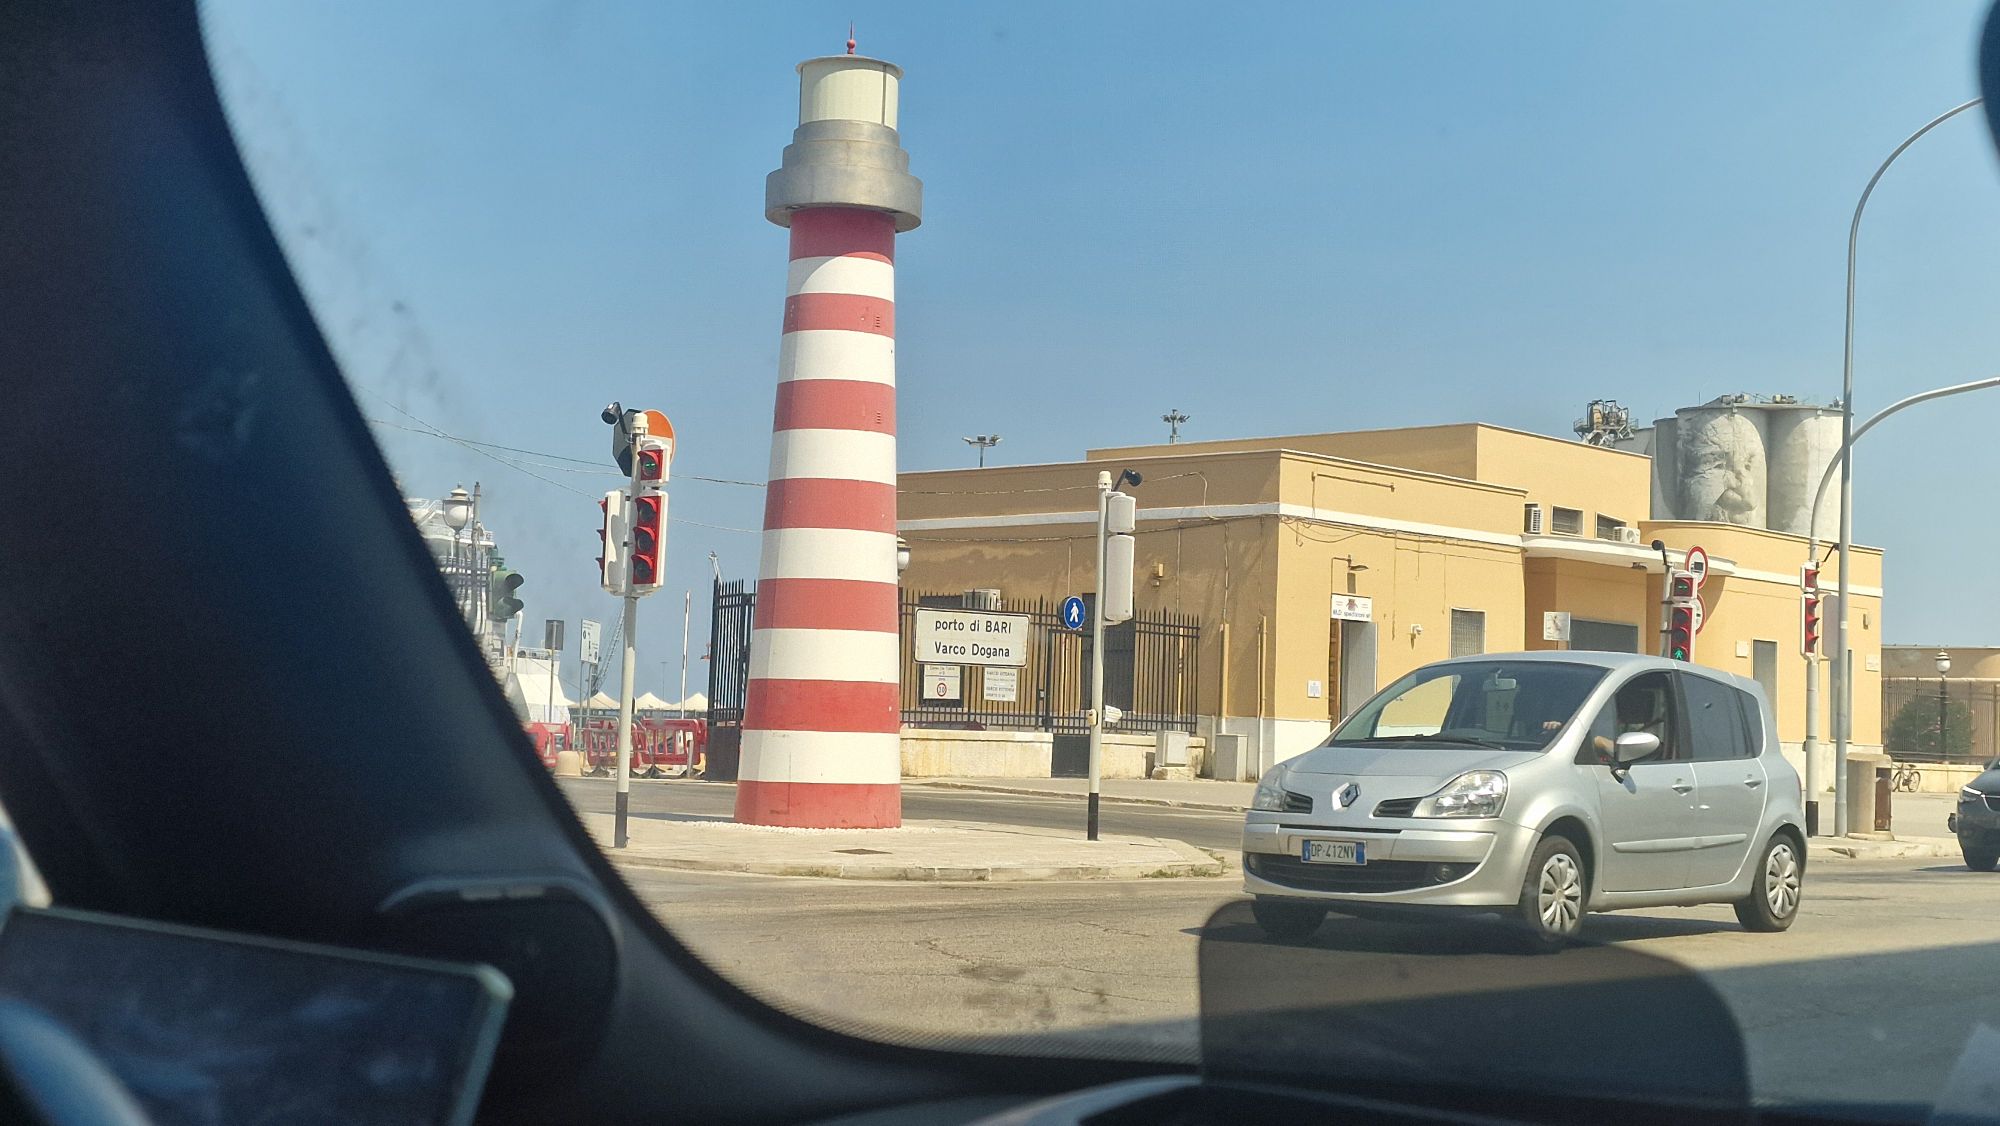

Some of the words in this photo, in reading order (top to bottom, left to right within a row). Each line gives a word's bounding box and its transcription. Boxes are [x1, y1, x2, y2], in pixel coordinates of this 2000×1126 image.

[935, 619, 965, 631] porto
[970, 619, 980, 632] di
[985, 620, 1012, 634] BARI
[935, 641, 966, 655] Varco
[971, 643, 1010, 659] Dogana
